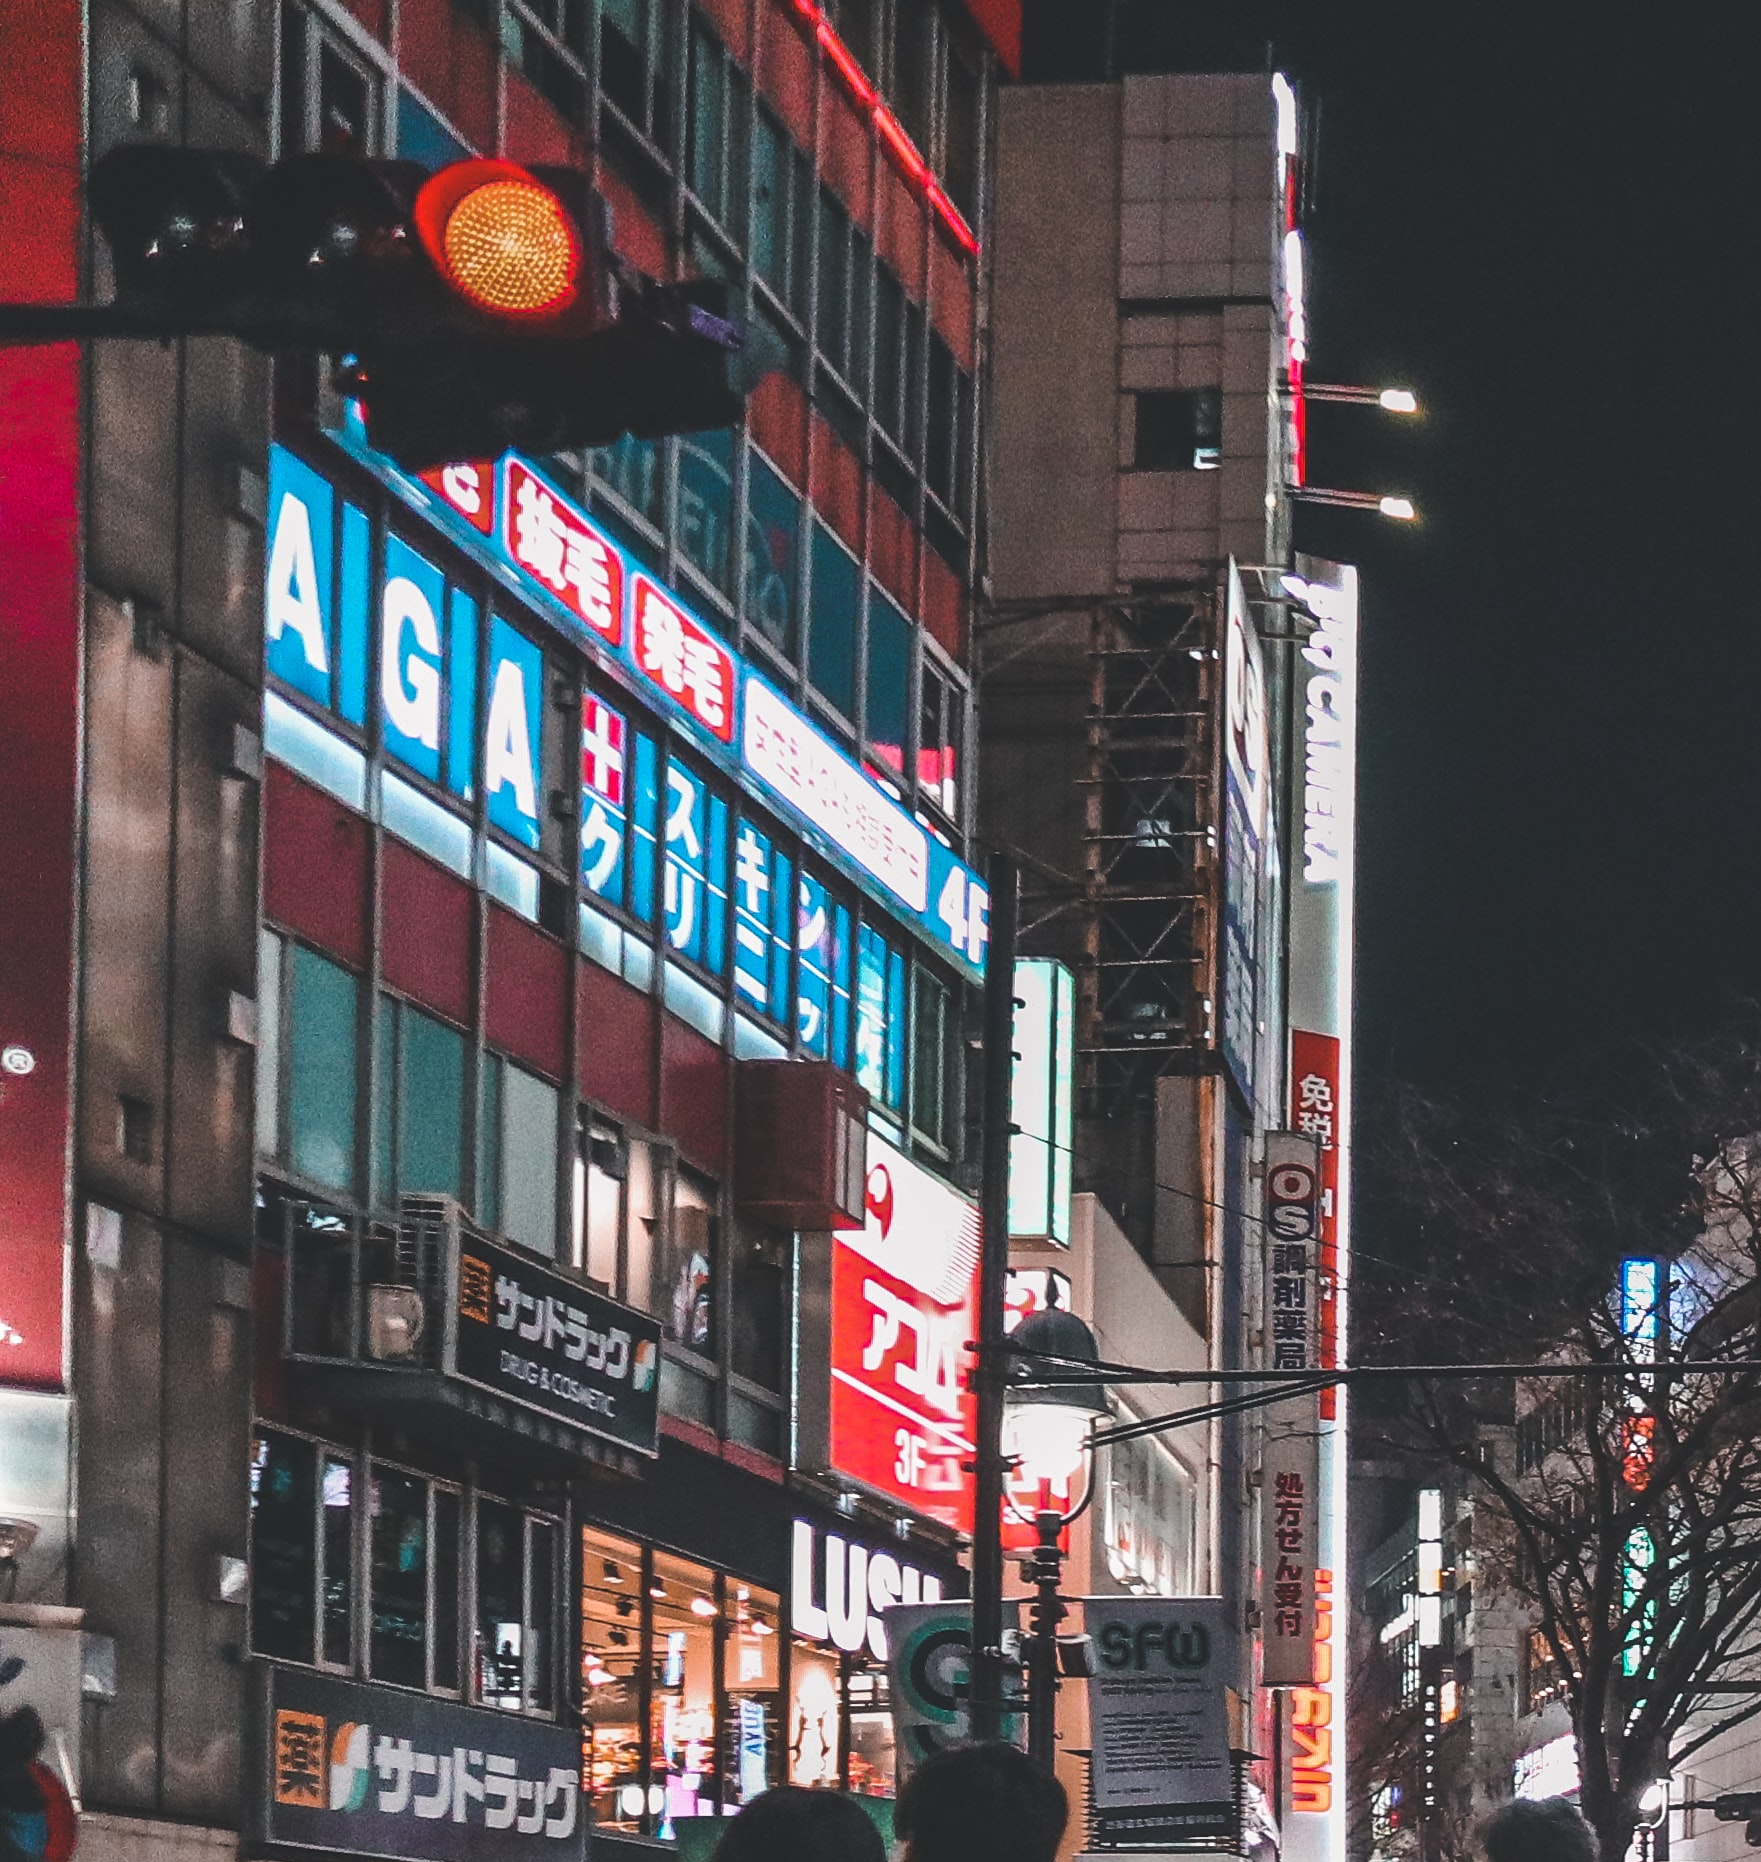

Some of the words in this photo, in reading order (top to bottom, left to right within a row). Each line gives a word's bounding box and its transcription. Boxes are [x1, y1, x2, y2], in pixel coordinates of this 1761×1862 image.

[266, 490, 540, 818] AGA
[937, 865, 991, 965] 4F
[494, 1274, 632, 1380] サンドラッグ
[1272, 1243, 1306, 1371] 調剤薬局
[893, 1428, 928, 1487] 3F
[1273, 1471, 1304, 1638] 処方せん受付
[371, 1734, 581, 1839] サンドラッグ
